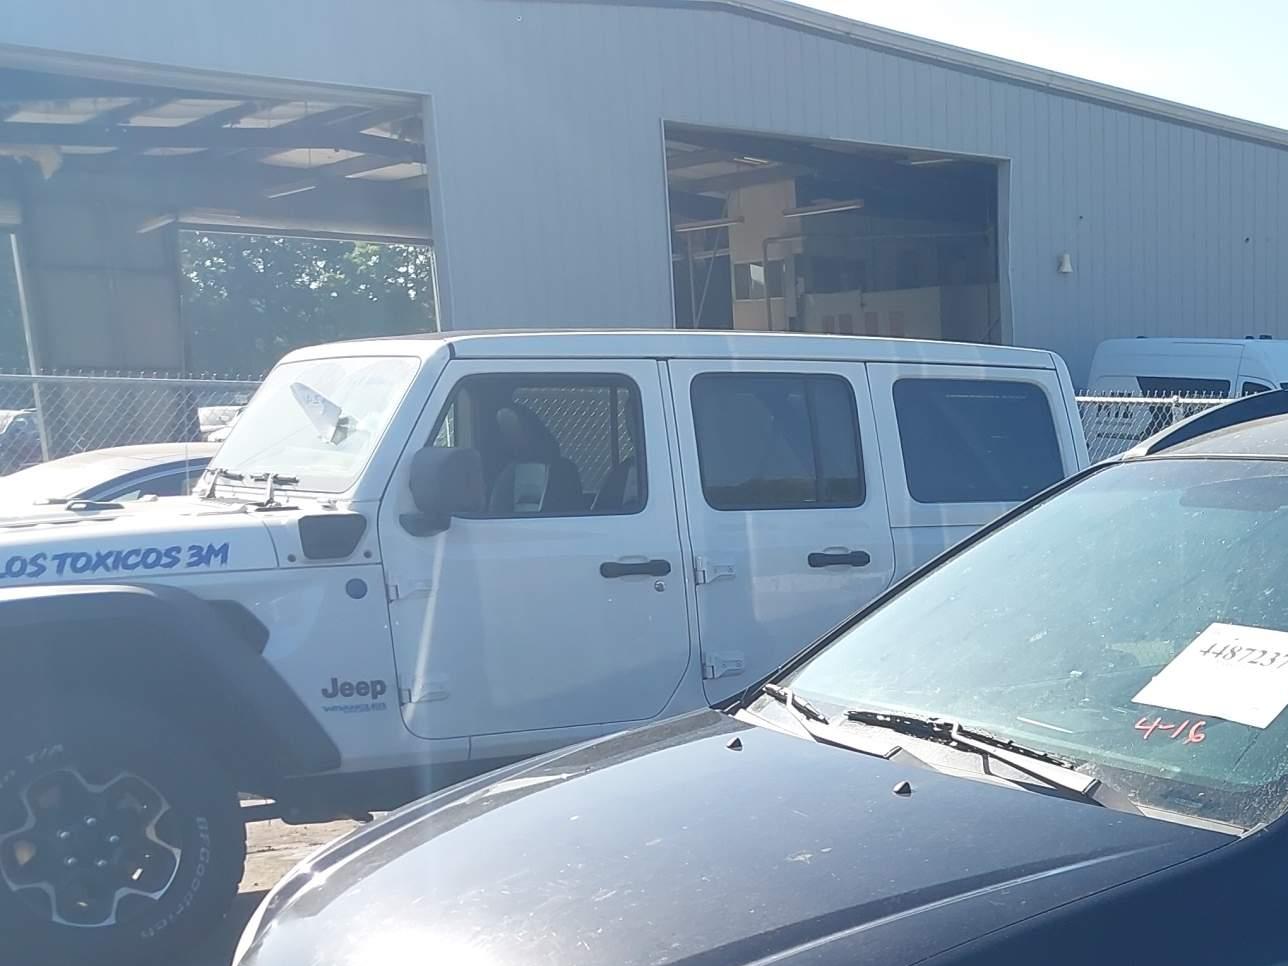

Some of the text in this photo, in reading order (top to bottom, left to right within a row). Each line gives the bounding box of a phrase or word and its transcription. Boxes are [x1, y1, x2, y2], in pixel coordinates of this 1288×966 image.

[52, 546, 183, 576] TOXICOS
[186, 542, 230, 568] 3M
[321, 677, 387, 700] Jeep
[1134, 716, 1206, 745] 4-16
